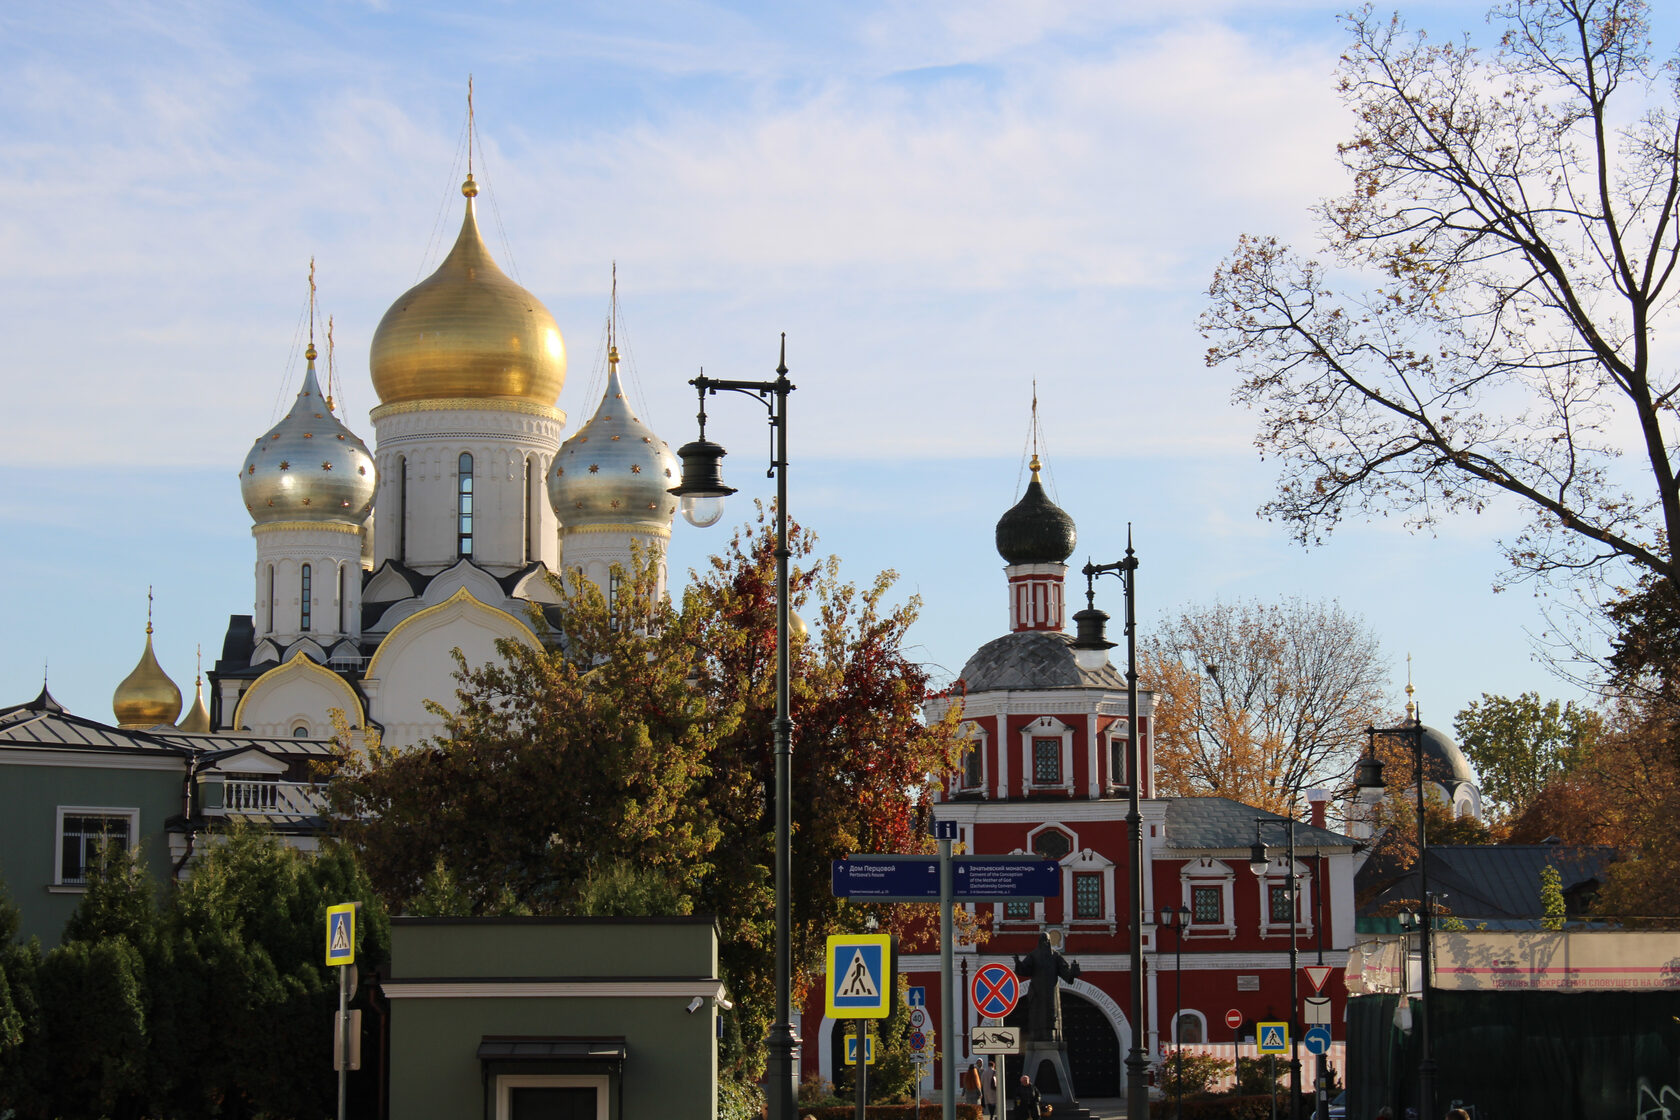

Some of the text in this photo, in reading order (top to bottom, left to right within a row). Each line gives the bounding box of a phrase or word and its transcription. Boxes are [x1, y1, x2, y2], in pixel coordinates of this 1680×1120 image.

[1492, 979, 1528, 988] ЦЕРКОВЬ
[1531, 979, 1588, 988] ВОСКРЕСЕНИЯ
[1589, 979, 1639, 988] СЛОВУЩЕГО
[1640, 979, 1651, 987] НА
[912, 1014, 922, 1022] 40
